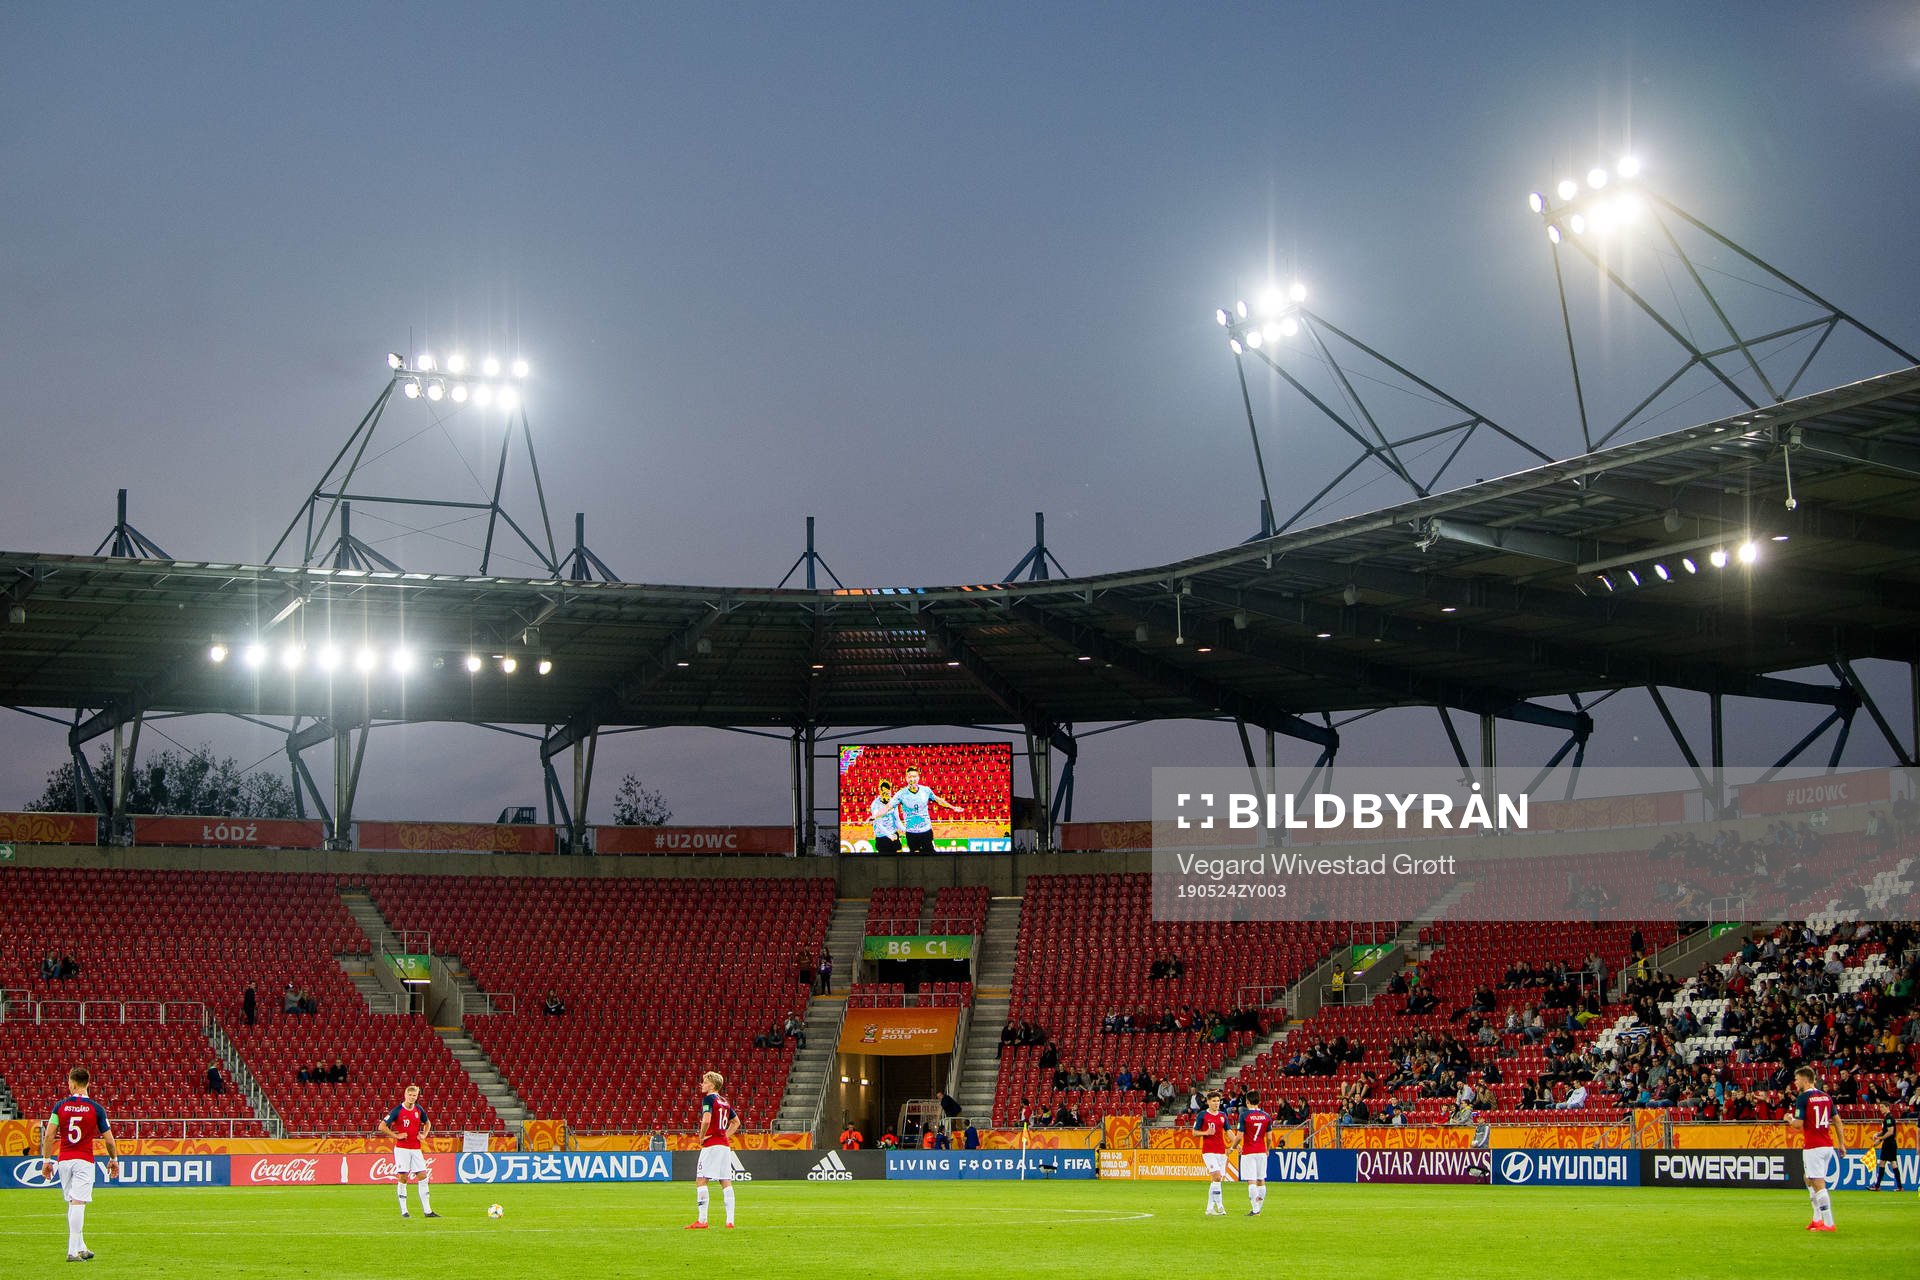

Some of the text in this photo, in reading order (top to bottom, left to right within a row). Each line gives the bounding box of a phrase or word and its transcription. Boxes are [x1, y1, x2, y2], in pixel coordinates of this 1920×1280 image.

[1786, 783, 1849, 806] #U20WC
[203, 822, 257, 841] ŁÓDŹ
[655, 833, 737, 849] #U20WC
[888, 941, 948, 955] B6 C1
[882, 1027, 938, 1035] POLAND
[402, 1119, 411, 1128] 19
[718, 1107, 728, 1130] 16
[1813, 1105, 1830, 1129] 14
[67, 1116, 83, 1144] 5
[1253, 1122, 1263, 1142] 7
[500, 1154, 562, 1181] 万达
[563, 1154, 670, 1179] WANDA
[889, 1159, 950, 1171] LIVING
[1064, 1158, 1093, 1170] FIFA
[1138, 1153, 1149, 1164] GET
[1150, 1153, 1166, 1164] YOUR
[1167, 1153, 1189, 1164] TICKETS
[1275, 1151, 1319, 1180] VISA
[1358, 1151, 1490, 1180] QATAR AIRWAYS
[1538, 1155, 1627, 1180] HYUNDAI
[96, 1160, 212, 1183] YUNDAI
[806, 1169, 853, 1181] adidas
